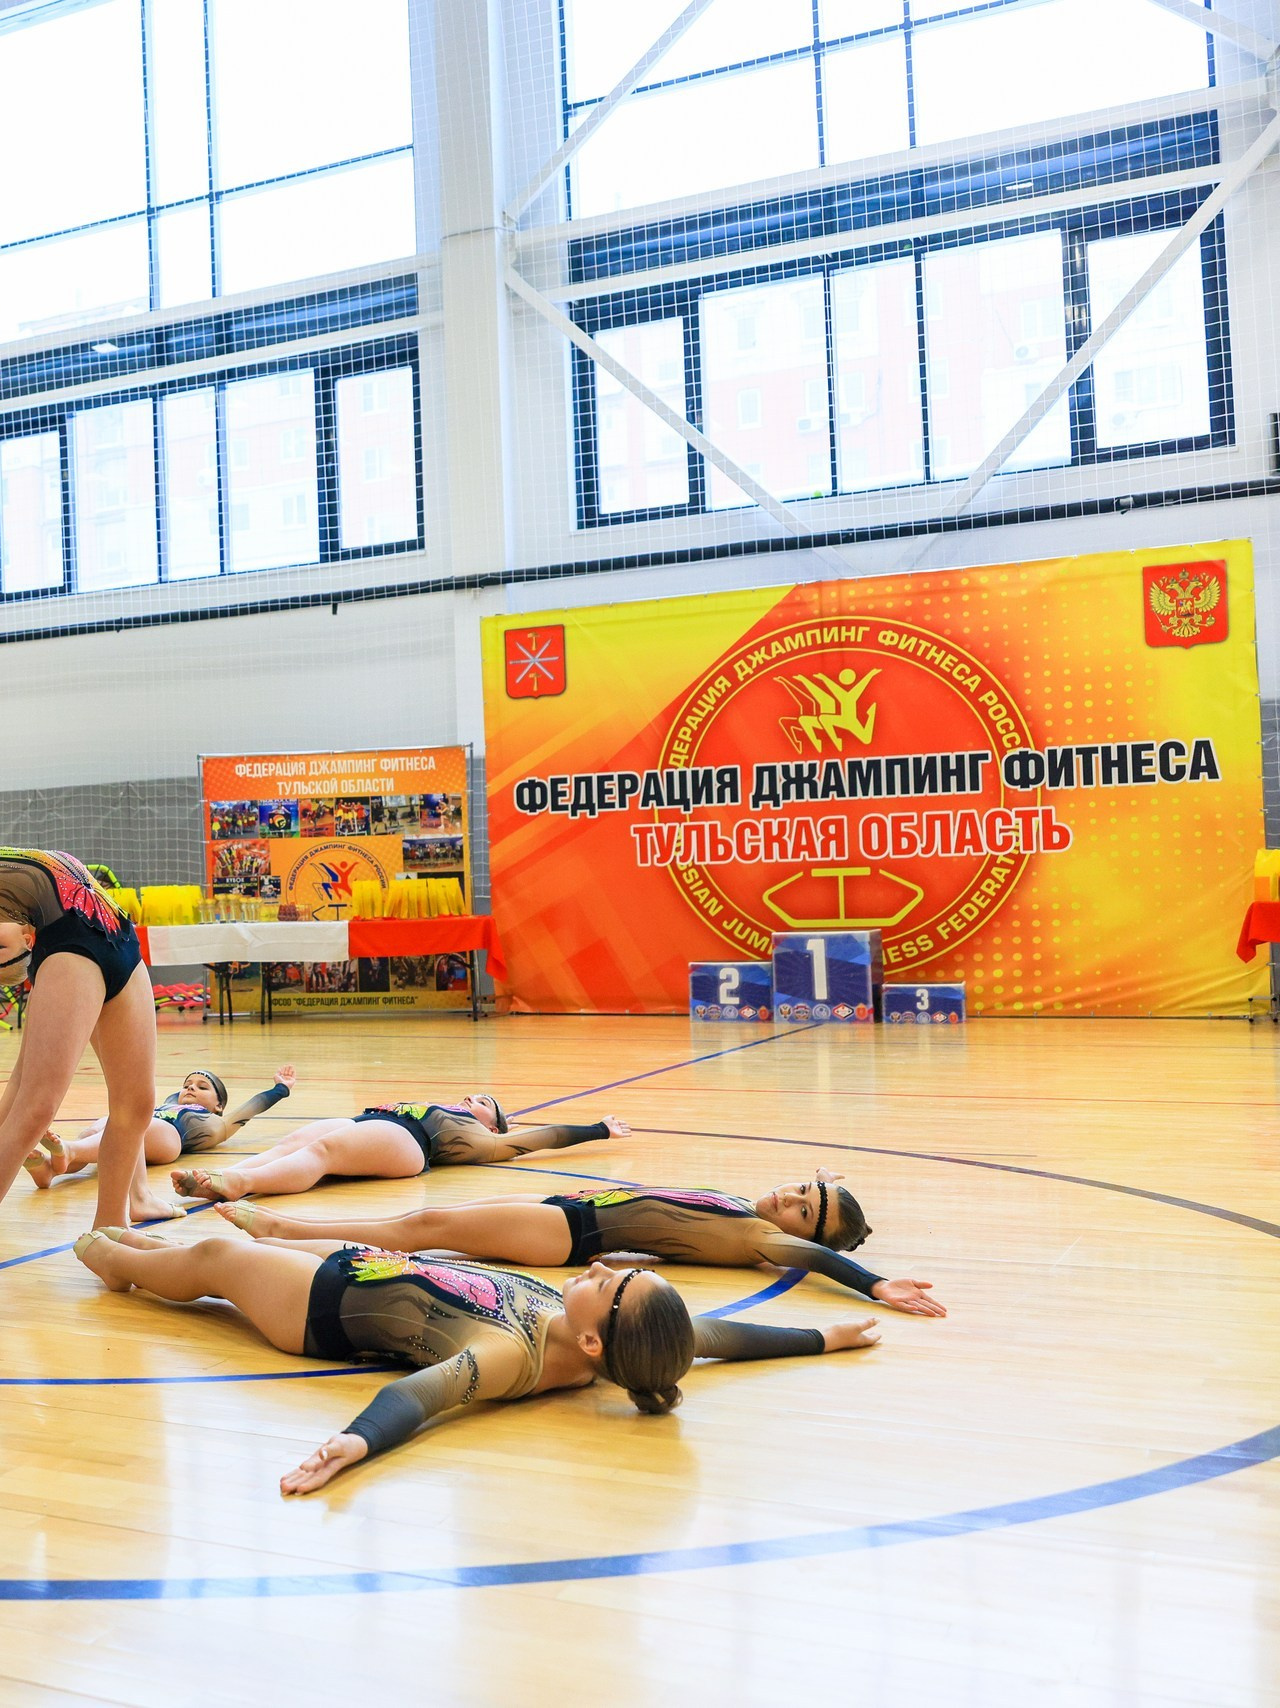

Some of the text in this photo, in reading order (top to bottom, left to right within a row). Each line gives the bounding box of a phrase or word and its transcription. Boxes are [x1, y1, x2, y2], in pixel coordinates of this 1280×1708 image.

[669, 626, 1024, 769] ДЕРАЦИЯ ДЖАМПИНГ ФИТНЕСА РОСС
[235, 756, 436, 779] ФЕДЕРАЦИЯ ДЖАМПИНГ ФИТНЕСА
[277, 778, 395, 796] ТУЛЬСКОЙ ОБЛАСТИ
[515, 737, 1222, 818] ФЕДЕРАЦИЯ ДЖАМПИНГ ФИТНЕСА
[631, 806, 1074, 867] ТУЛЬСКАЯ ОБЛАСТЬ
[289, 855, 309, 891] ФЕДЕРАЦИЯ
[309, 843, 346, 858] ДЖАМПИНГ
[347, 845, 374, 865] ФИТНЕСА
[719, 967, 740, 1004] 2
[806, 938, 828, 1001] 1
[340, 996, 380, 1006] ДЖАМПИНГ
[916, 988, 930, 1010] 3
